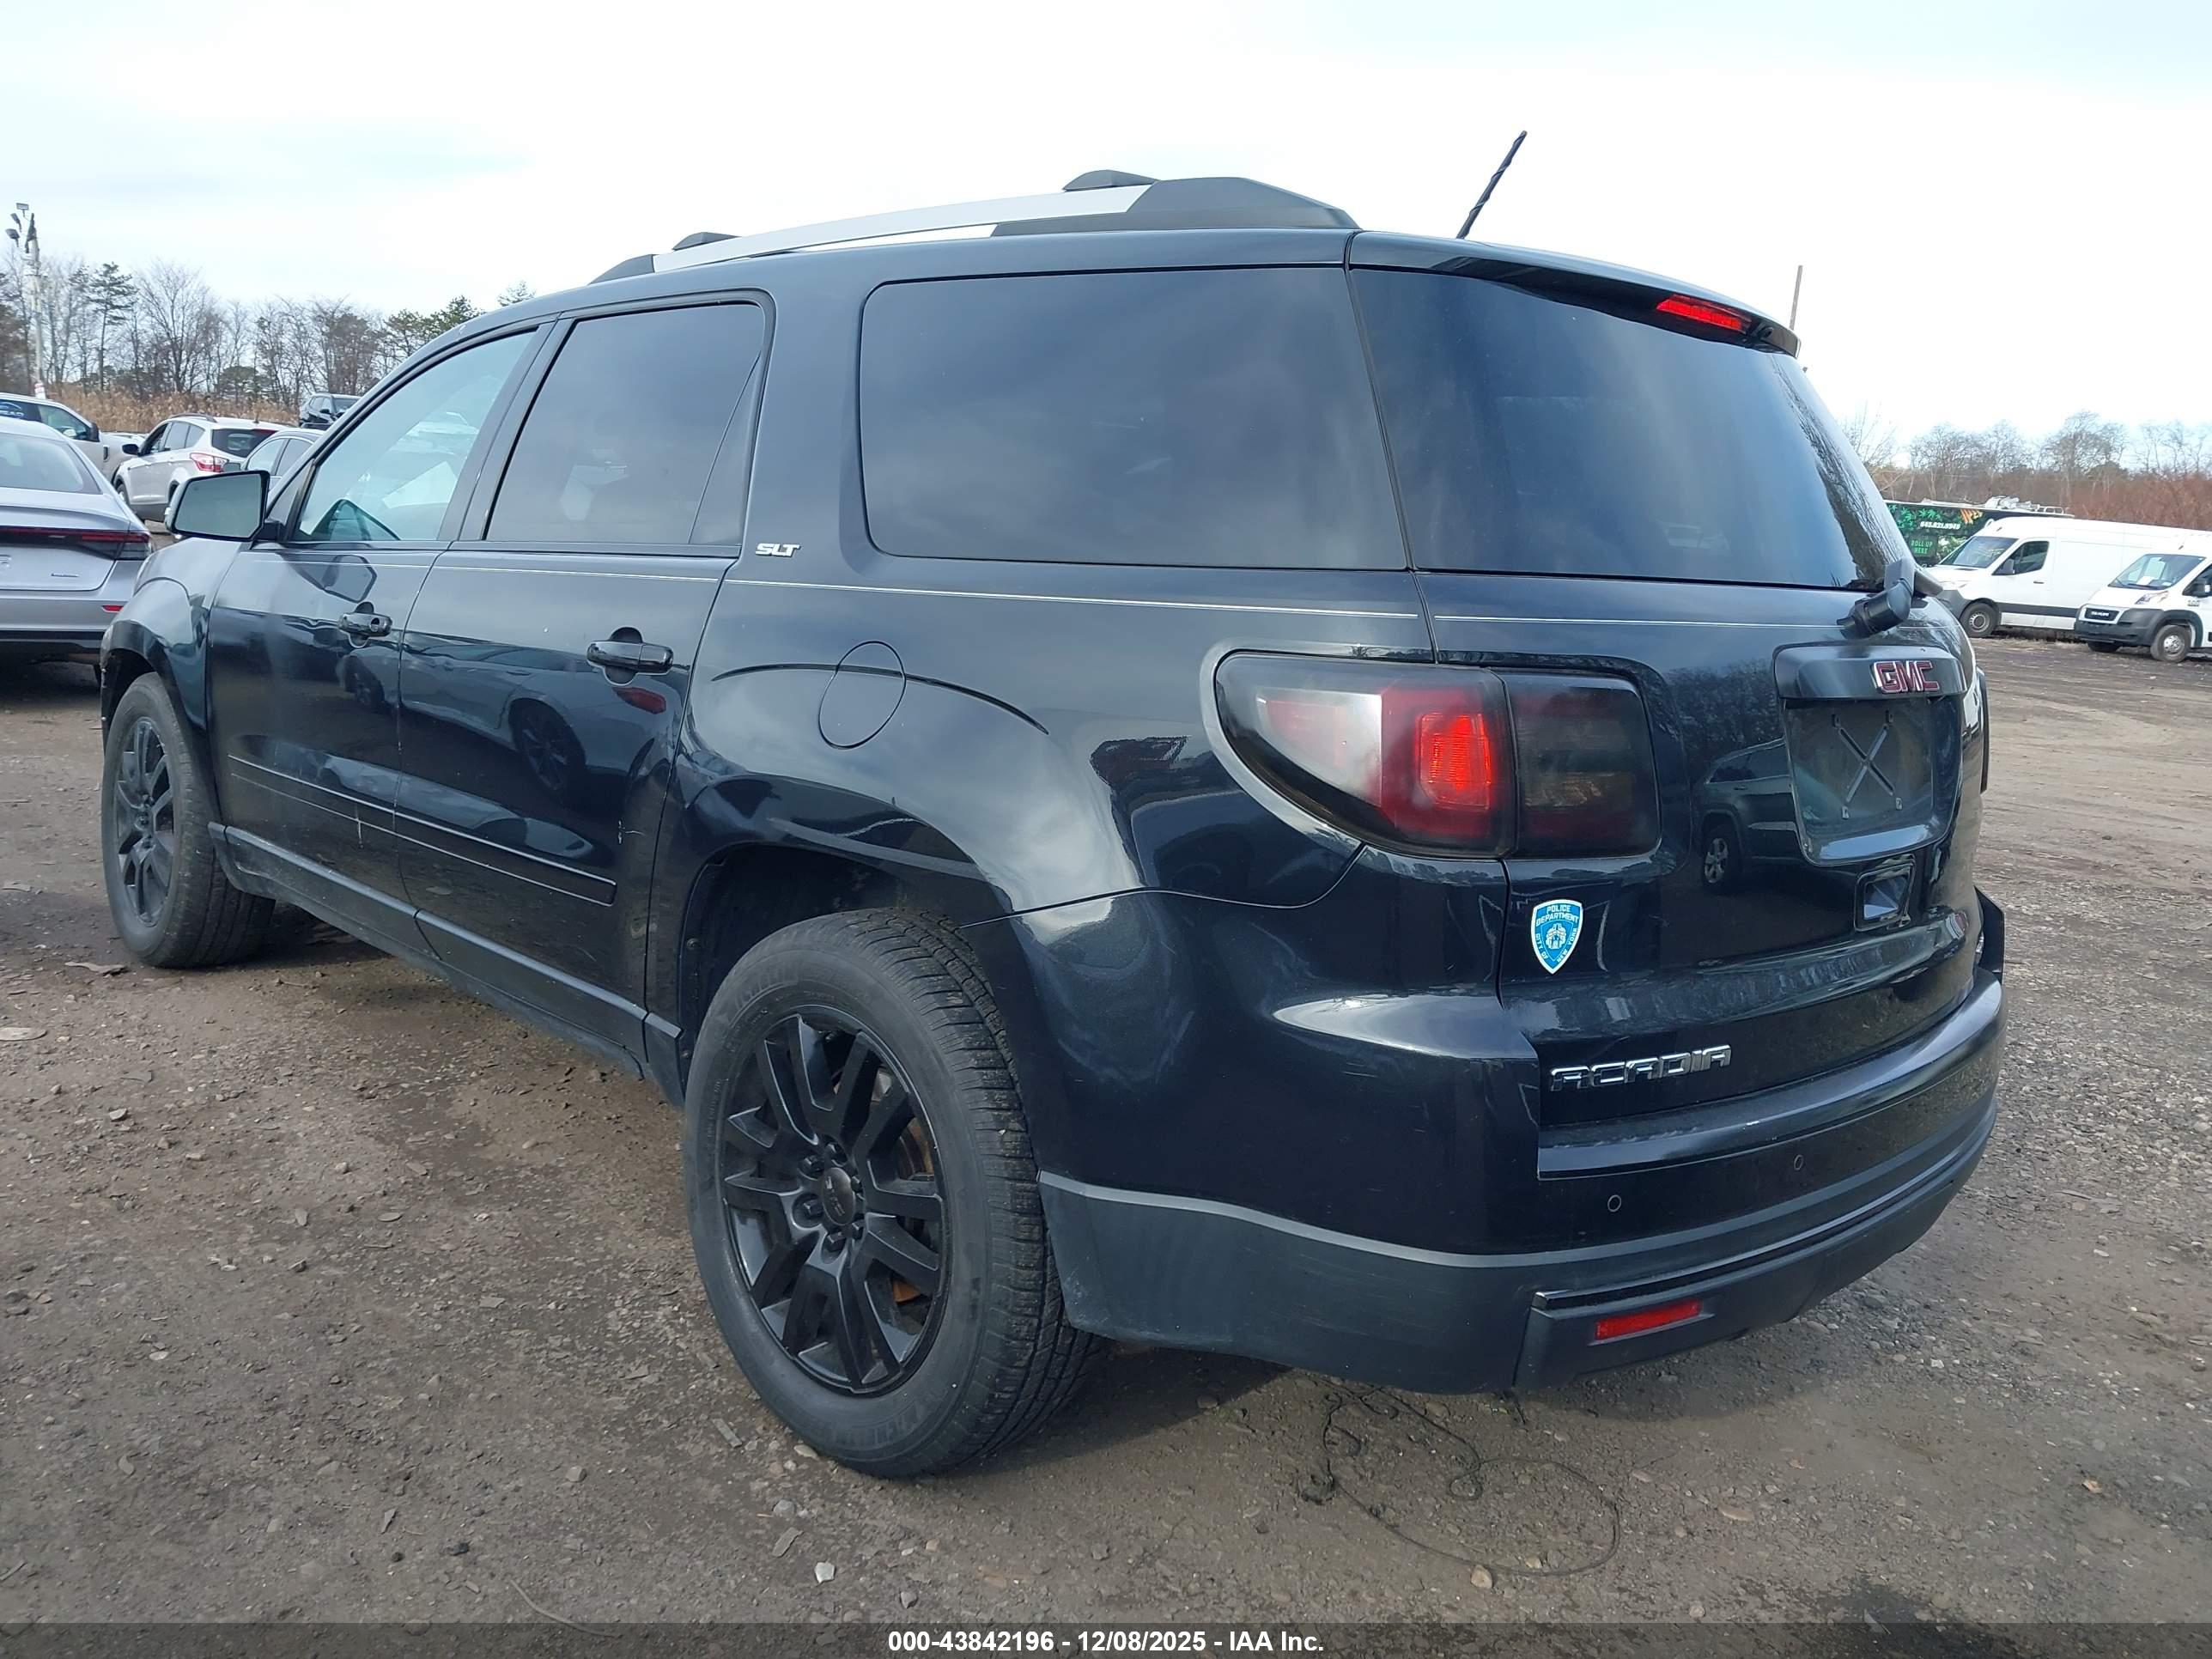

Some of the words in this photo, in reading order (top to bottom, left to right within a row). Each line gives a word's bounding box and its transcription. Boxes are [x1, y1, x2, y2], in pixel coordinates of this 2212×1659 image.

[755, 543, 801, 557] SLT
[1873, 659, 1940, 694] GMC
[1547, 904, 1571, 914] POLICE
[1535, 912, 1579, 927] DEPARTMENT
[1550, 1043, 1732, 1092] ACADIA
